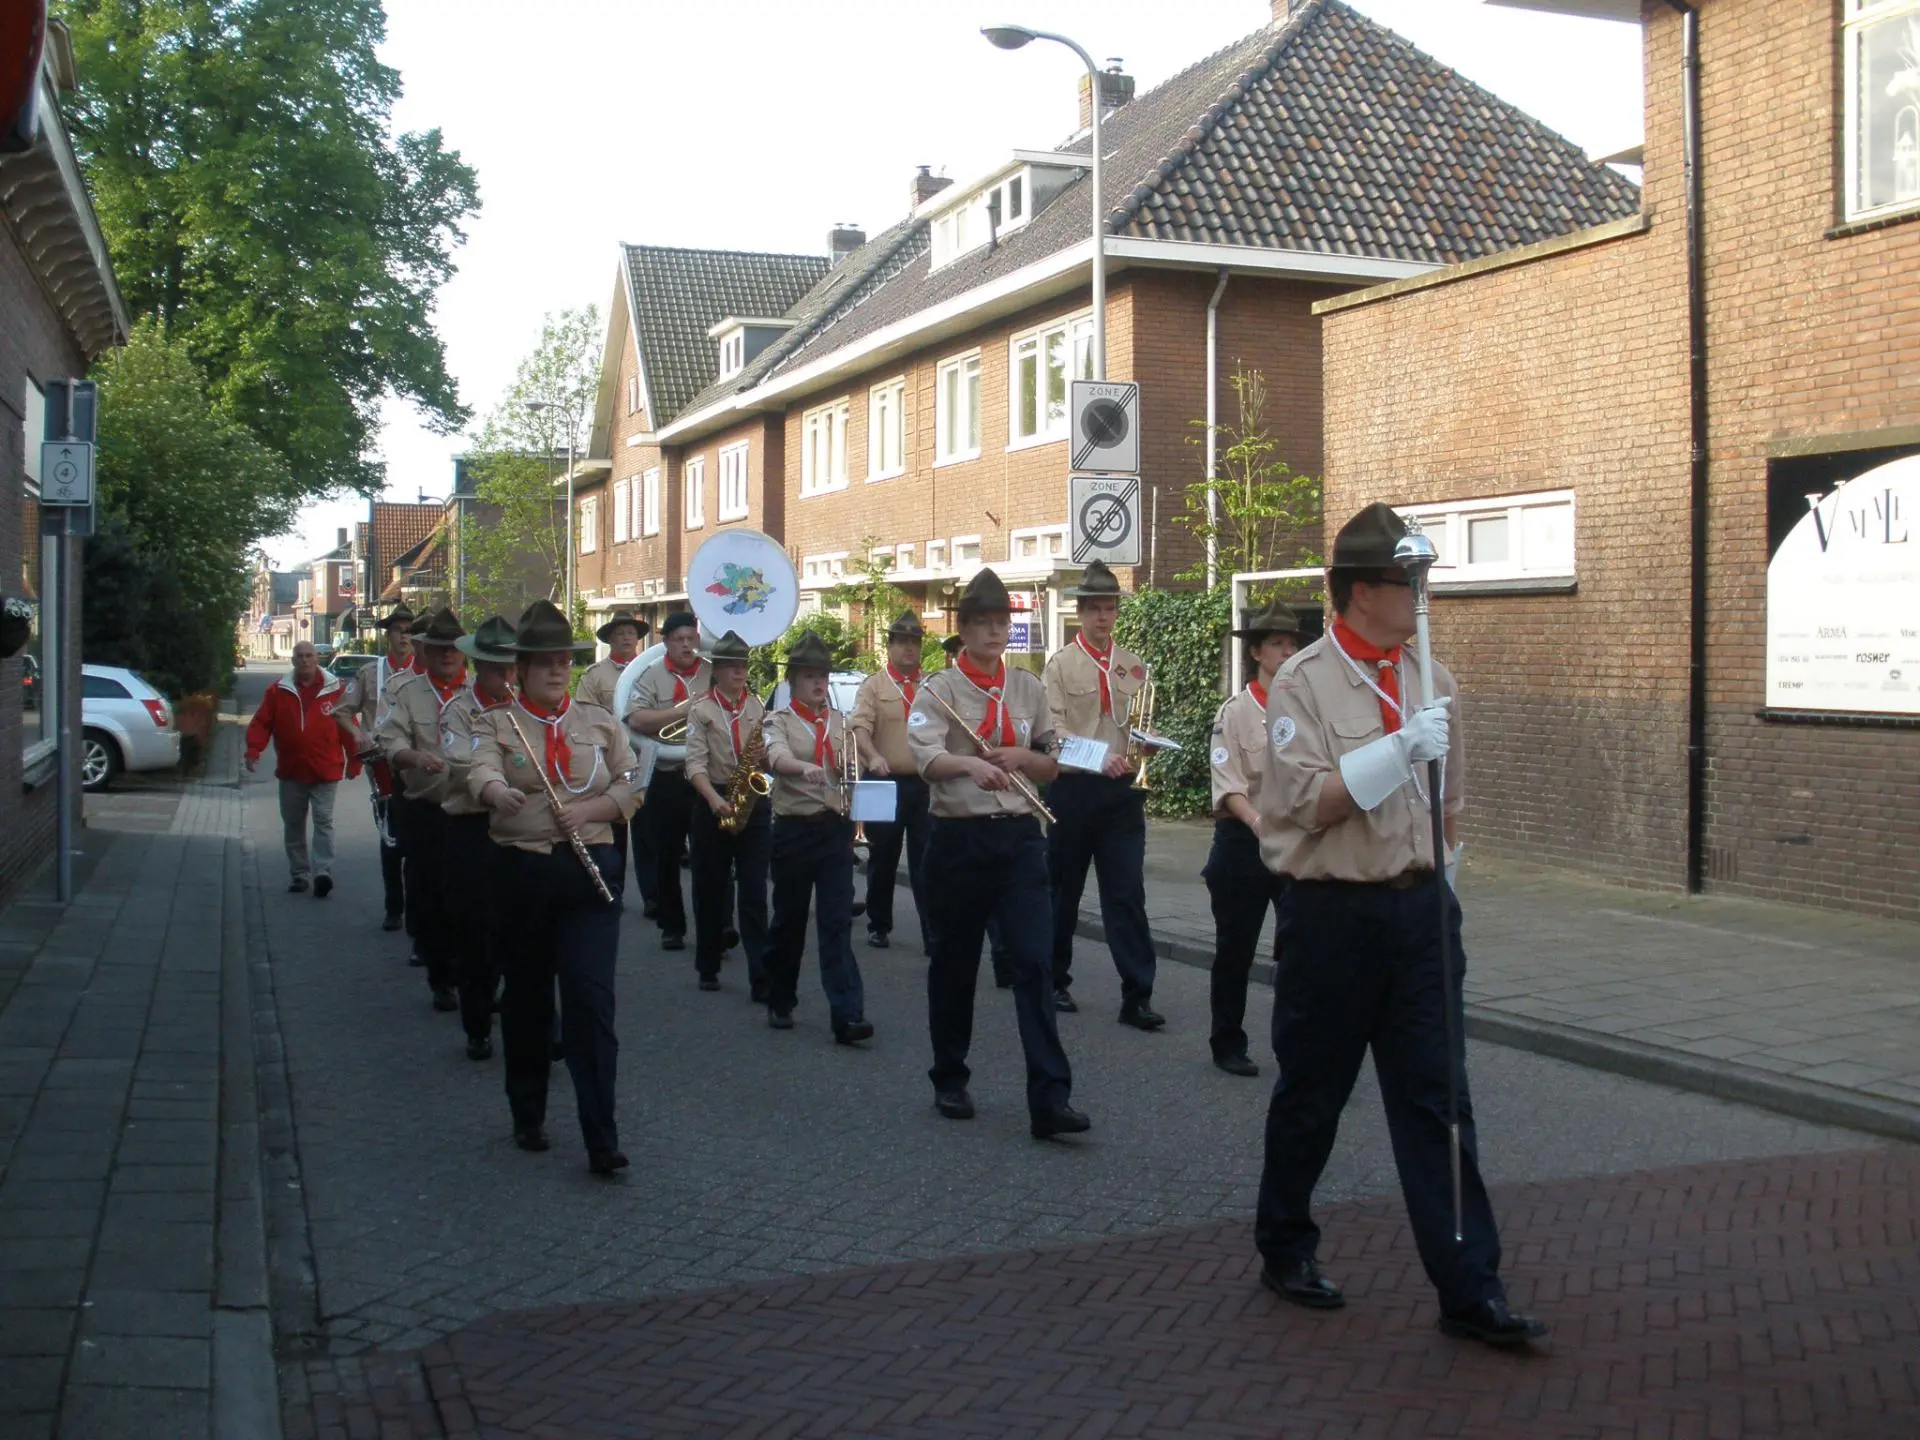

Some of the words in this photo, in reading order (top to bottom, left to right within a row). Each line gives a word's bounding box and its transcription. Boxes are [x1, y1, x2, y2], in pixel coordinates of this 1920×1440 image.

[1088, 386, 1121, 397] ZONE
[60, 467, 70, 478] 4
[1089, 482, 1119, 492] ZONE
[1088, 509, 1124, 533] 30
[1855, 651, 1891, 663] rosner
